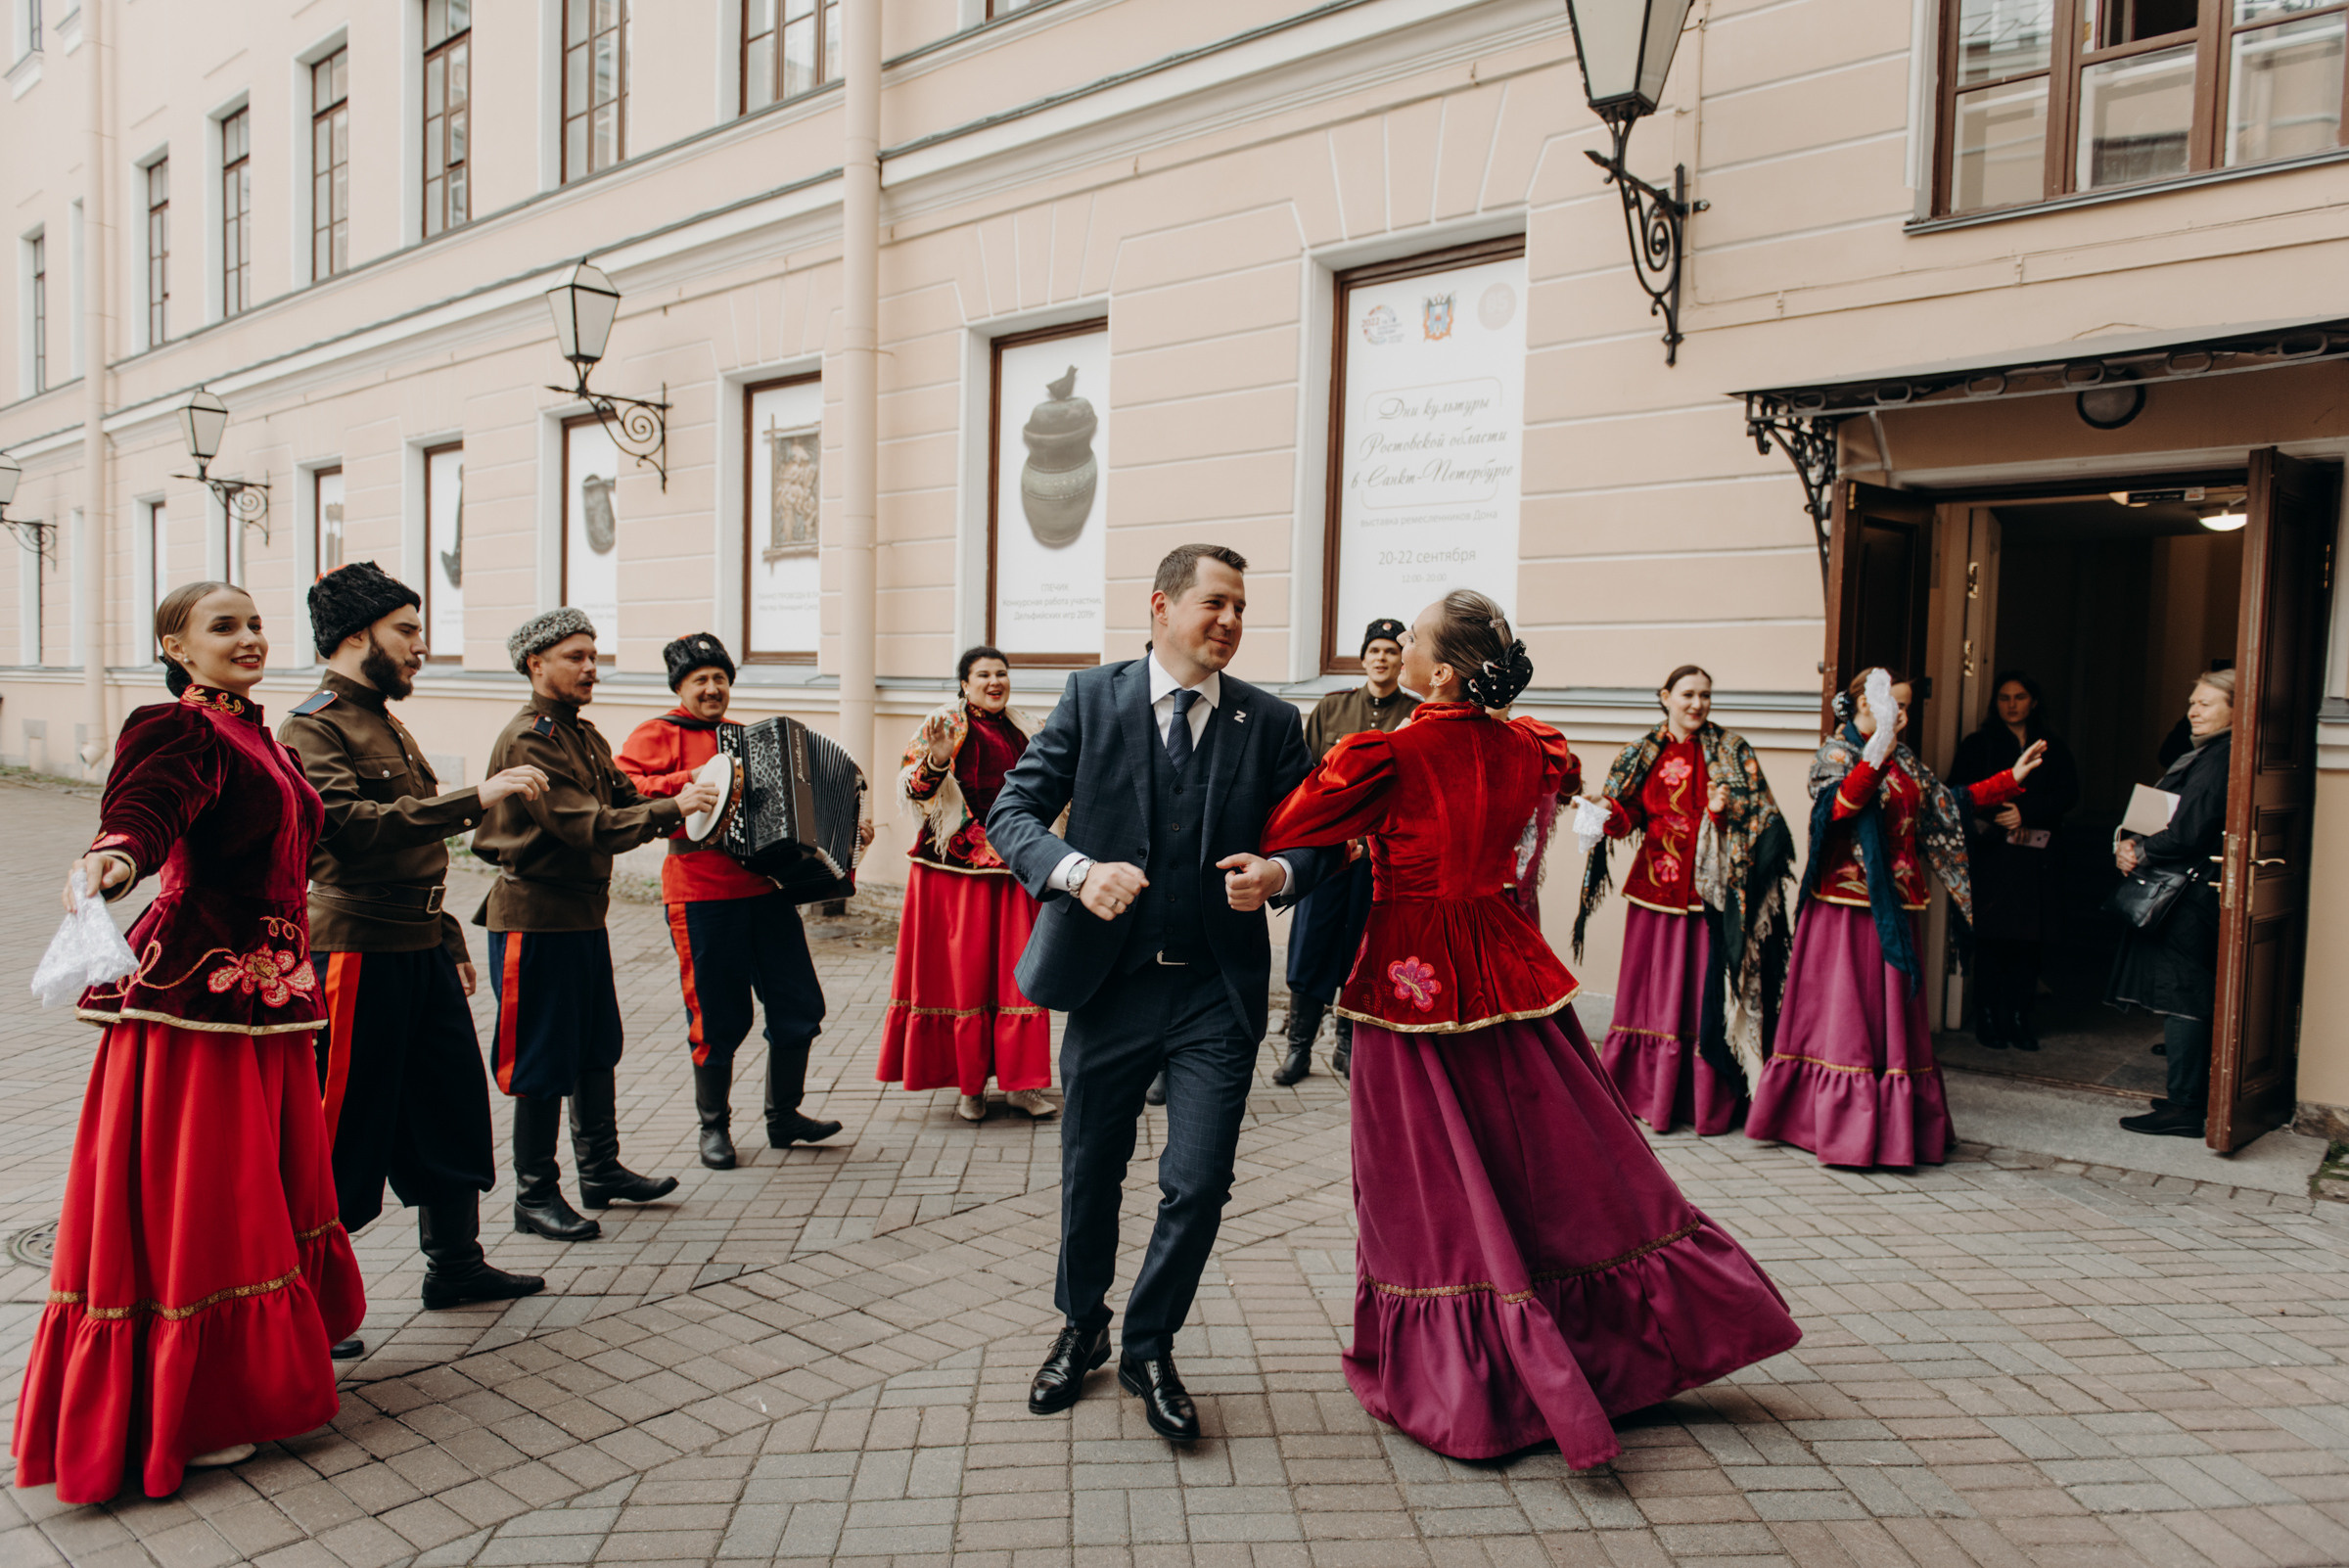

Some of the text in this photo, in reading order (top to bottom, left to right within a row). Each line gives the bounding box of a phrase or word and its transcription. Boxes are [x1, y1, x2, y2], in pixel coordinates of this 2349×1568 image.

[1377, 396, 1490, 421] Дни культуры
[1359, 426, 1508, 462] Ростовской области
[1350, 457, 1515, 488] в Санкт-Петербурге
[1359, 509, 1498, 528] выставка ремесленников Дона
[1378, 547, 1477, 565] 20-22 сентября
[1044, 596, 1069, 608] работа
